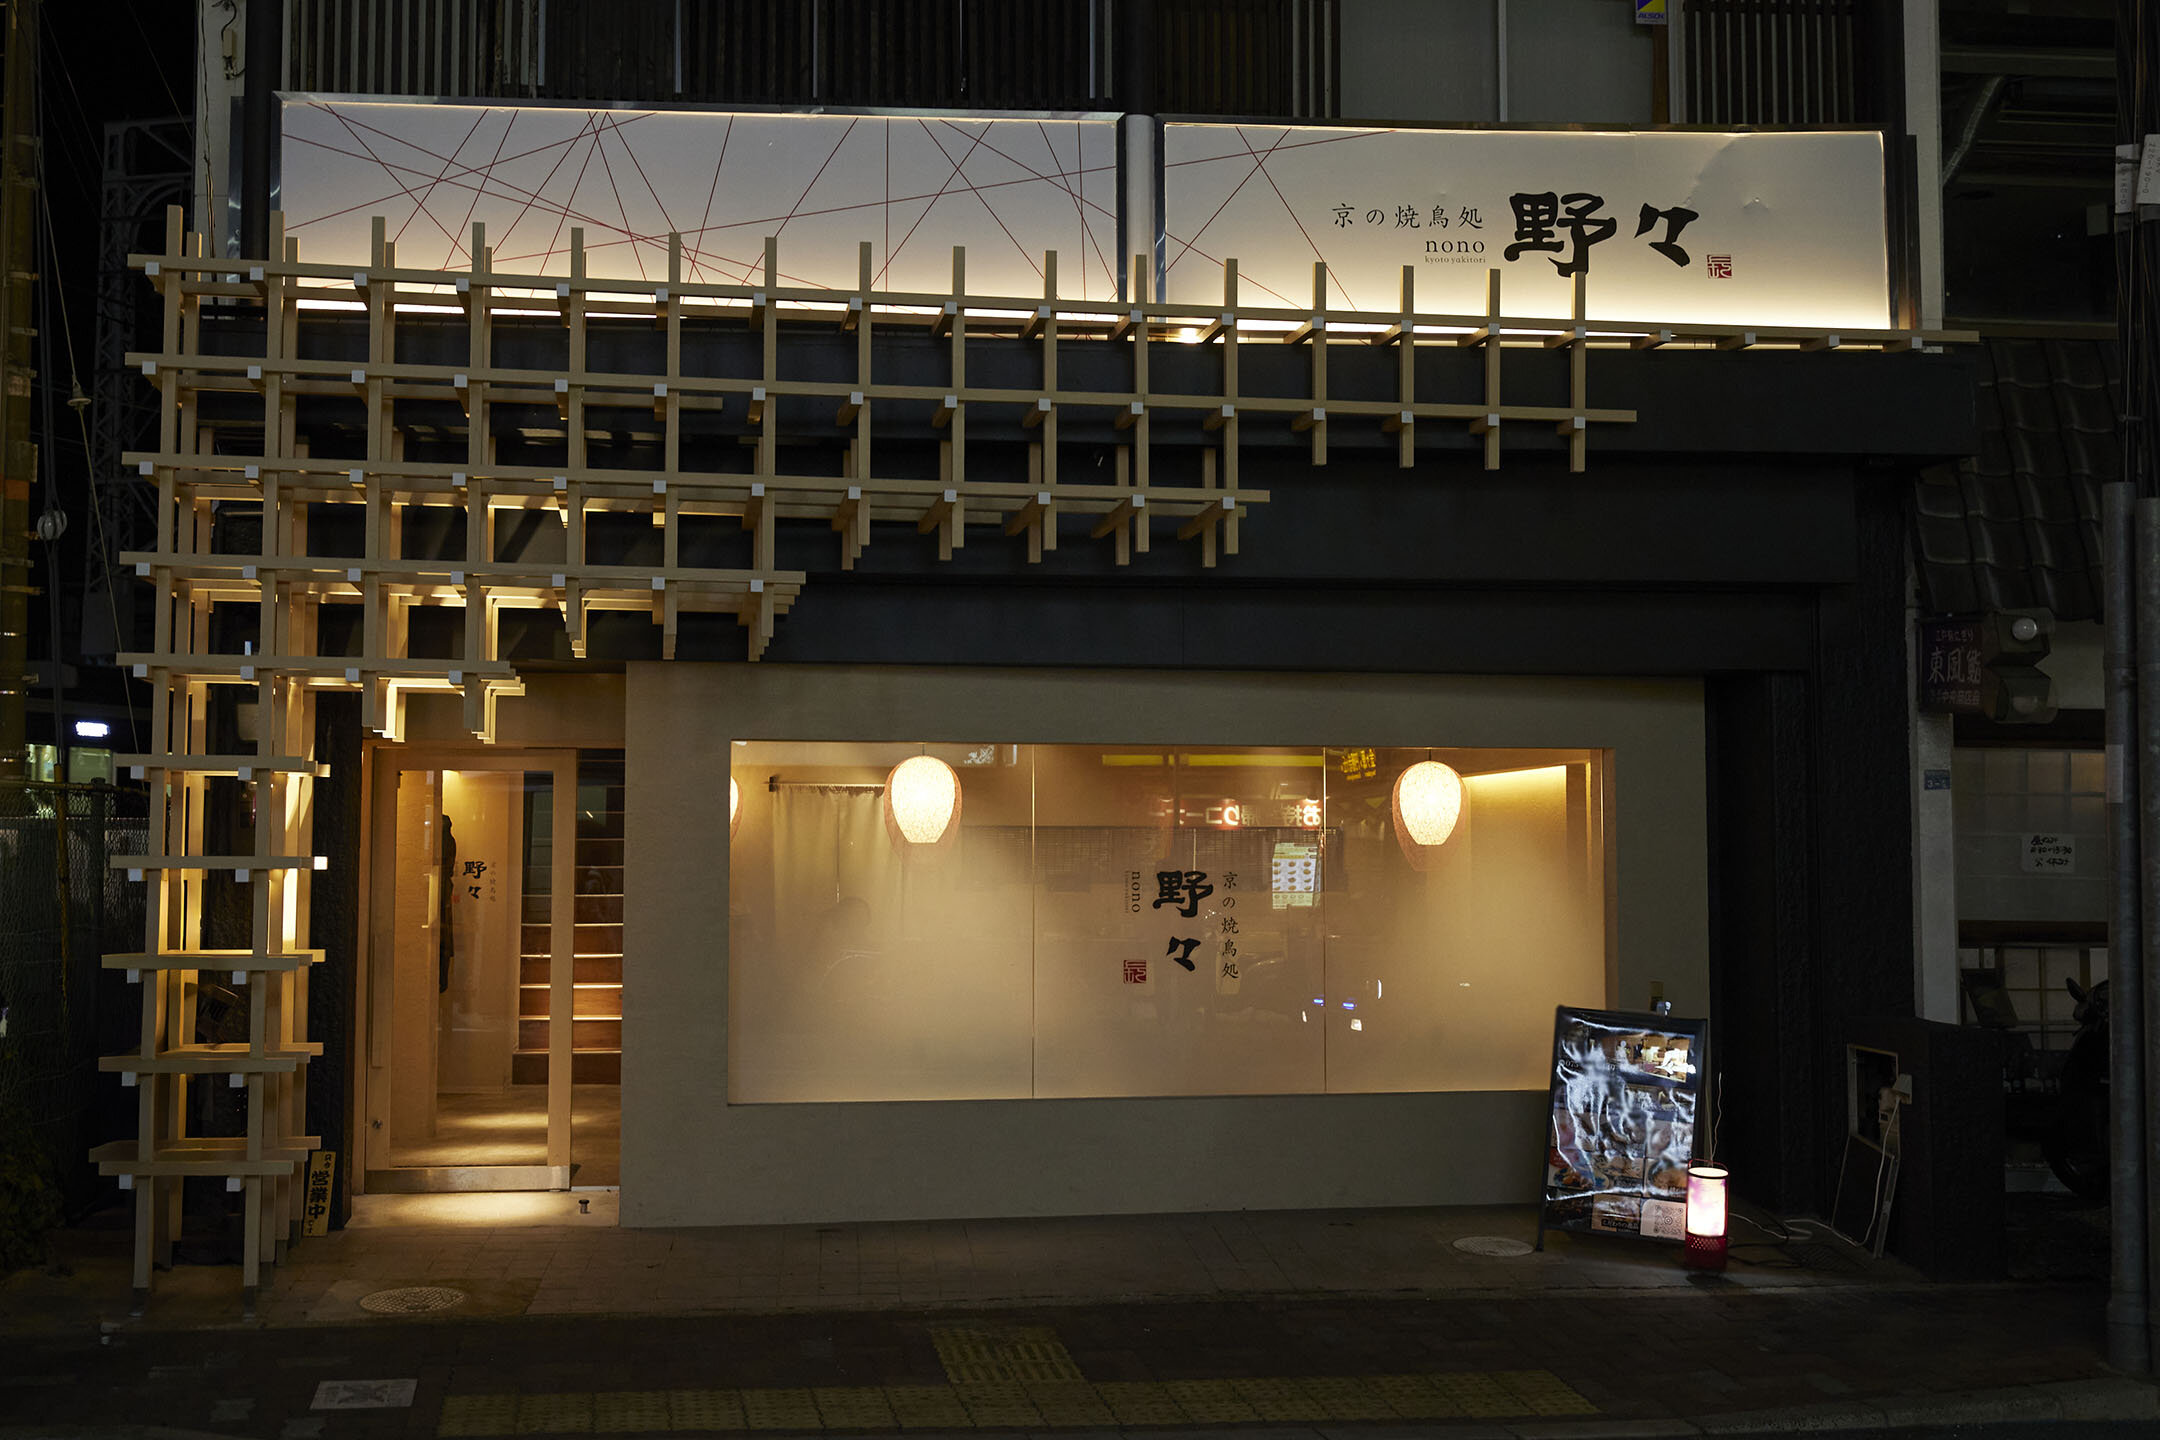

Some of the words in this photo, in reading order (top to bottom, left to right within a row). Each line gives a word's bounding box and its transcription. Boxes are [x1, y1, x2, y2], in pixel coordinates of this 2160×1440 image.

[1331, 202, 1484, 230] 京の焼鳥処
[1503, 191, 1699, 278] 野々
[1424, 255, 1449, 265] kyoto
[1451, 255, 1486, 265] yakitori
[1425, 239, 1485, 253] nono
[462, 860, 487, 899] 野々
[1131, 871, 1141, 913] nono
[1152, 870, 1213, 972] 野々
[1220, 871, 1239, 979] 京の焼鳥処
